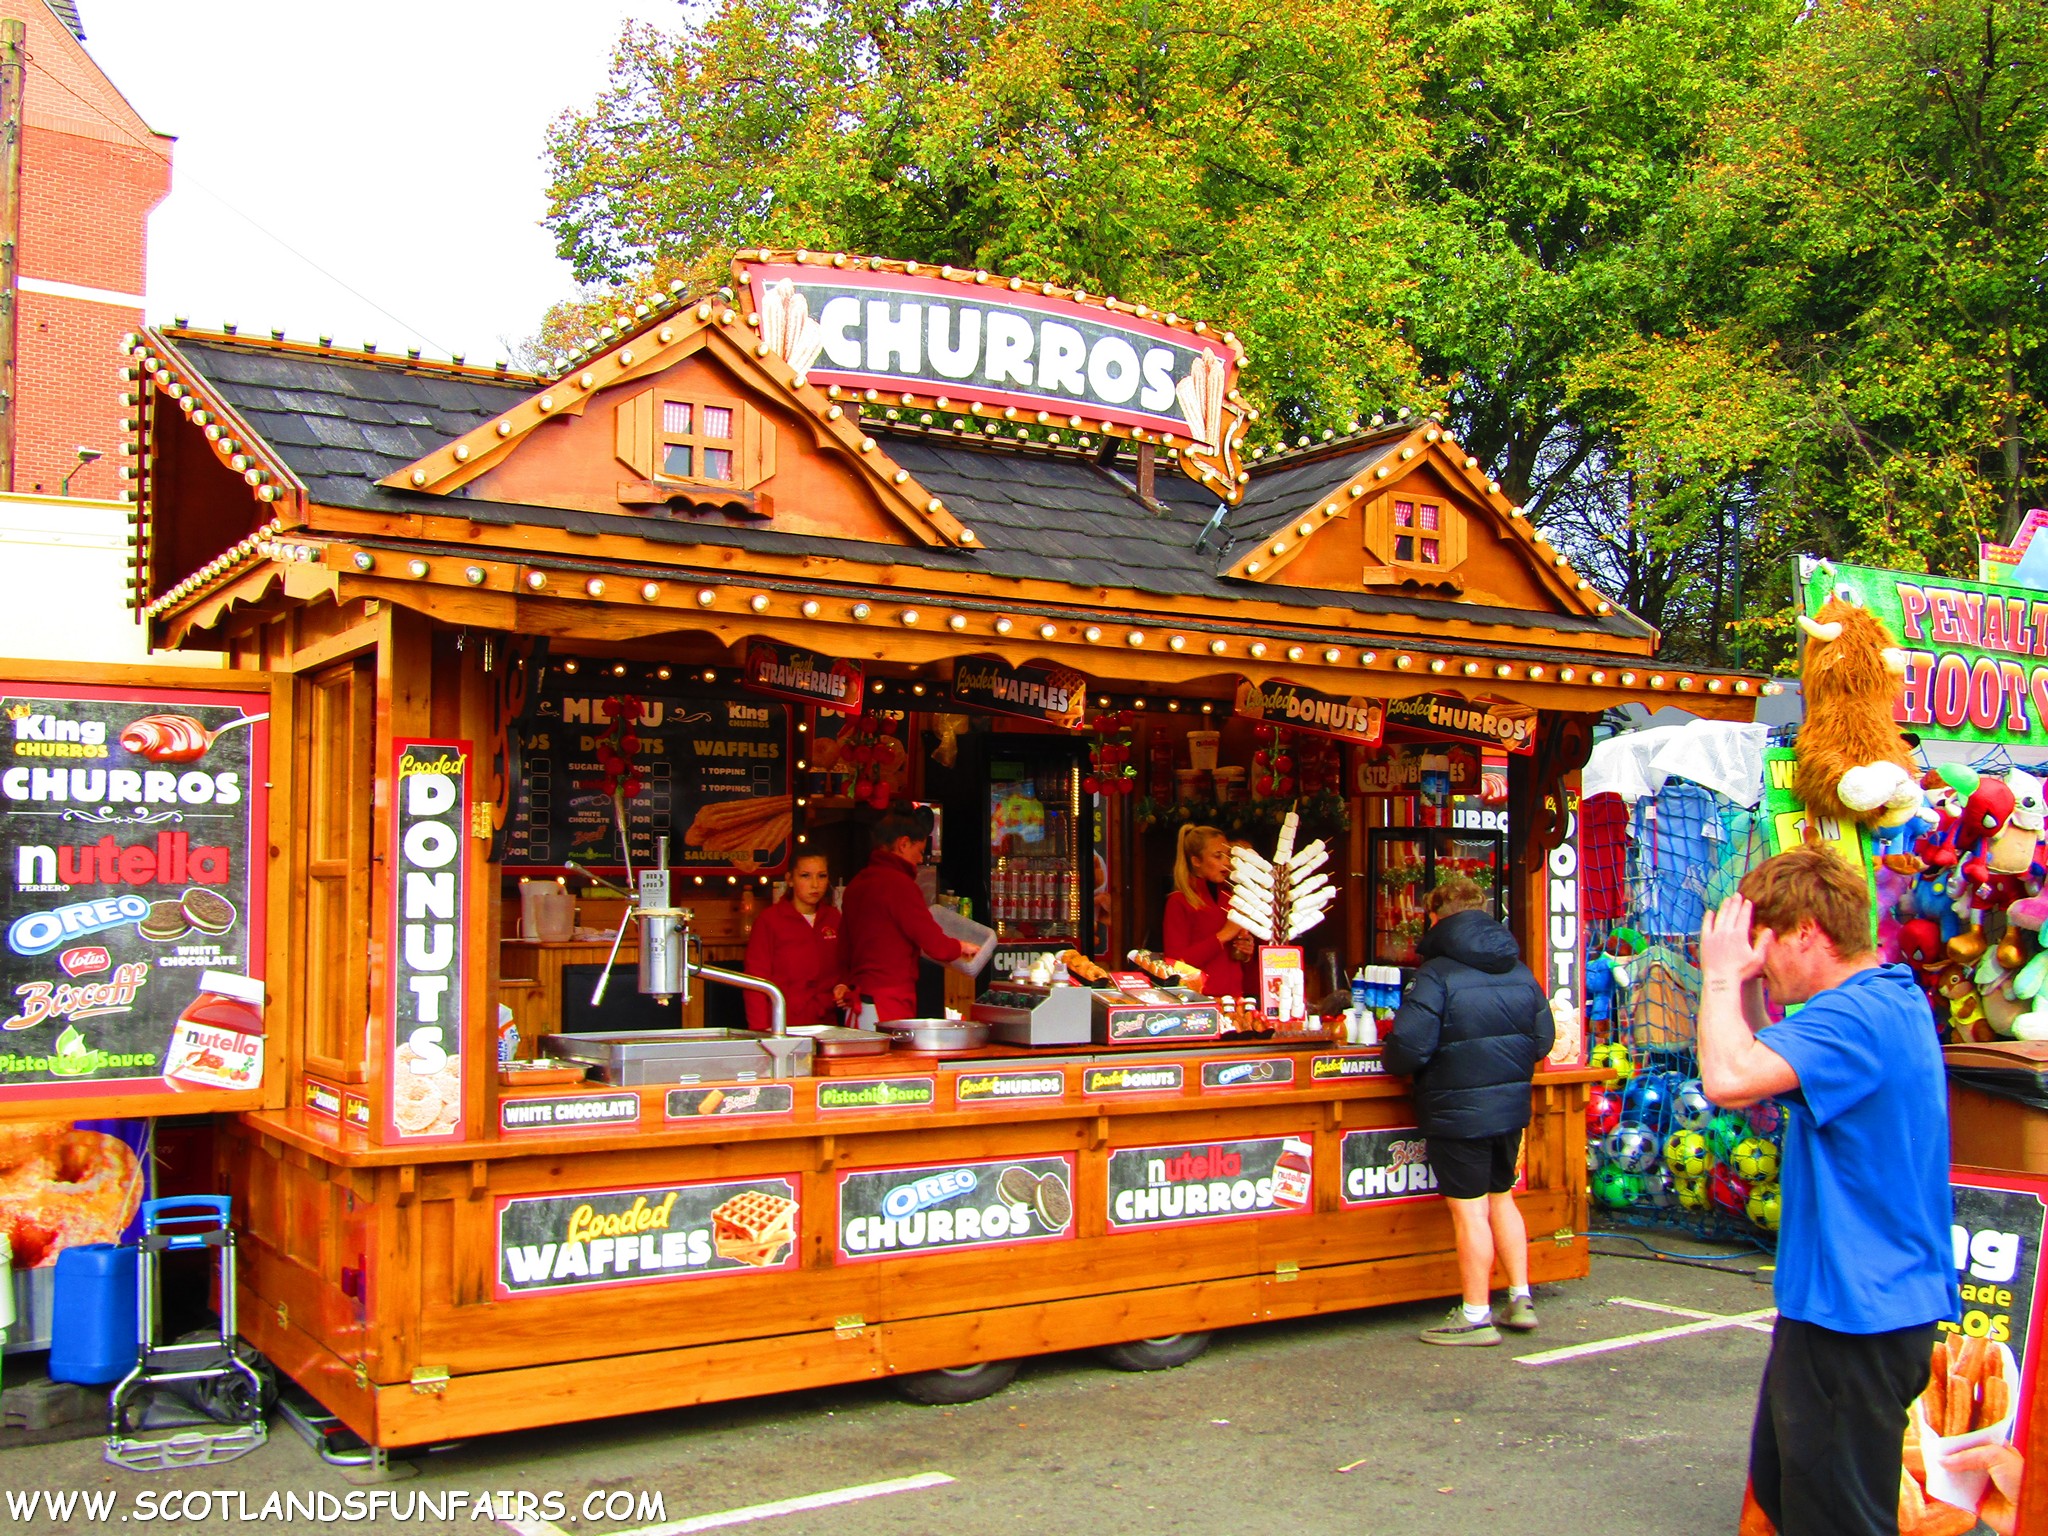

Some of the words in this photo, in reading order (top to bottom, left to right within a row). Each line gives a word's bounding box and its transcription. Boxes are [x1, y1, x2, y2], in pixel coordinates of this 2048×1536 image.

[820, 297, 1175, 412] CHURROS
[1895, 582, 2048, 657] PENALT
[760, 662, 846, 697] STRAWBERRIES
[956, 666, 1000, 691] Loaded
[993, 675, 1069, 713] WAFFLES
[1893, 650, 2048, 731] HOOT
[563, 697, 664, 728] MEU
[729, 705, 769, 721] King
[1245, 687, 1294, 710] Loaded
[1286, 698, 1368, 732] DONUTS
[1387, 696, 1436, 717] Loaded
[1428, 698, 1526, 741] CHURROS
[15, 714, 106, 745] King
[728, 719, 770, 729] CHURROS
[14, 742, 108, 758] CHURROS
[693, 740, 780, 758] WAFFLES
[399, 754, 468, 782] Loaded
[568, 763, 606, 771] SUGARE
[709, 768, 746, 776] TOPPING
[2, 767, 241, 805] CHURROS
[709, 785, 752, 793] TOPPINGS
[632, 815, 651, 823] FOR
[632, 832, 651, 841] FOR
[18, 831, 230, 885] nutella
[631, 849, 650, 857] FOR
[19, 884, 71, 892] FERRERO
[16, 894, 148, 950] OREO
[404, 774, 458, 1076] DONUTS
[67, 950, 107, 971] Lotus
[159, 955, 238, 967] CHOCOLATE
[177, 945, 221, 956] WHITE
[3, 961, 148, 1031] Biscoff
[186, 1029, 259, 1057] nutella
[97, 1051, 156, 1068] Sauce
[1313, 1058, 1345, 1077] Loaded
[1341, 1060, 1385, 1074] WAFFLE
[960, 1077, 1000, 1098] Loaded
[992, 1078, 1060, 1094] CHURROS
[1091, 1070, 1125, 1091] Loaded
[1121, 1072, 1175, 1087] DONUTS
[1219, 1064, 1252, 1084] OREO
[889, 1088, 929, 1102] Sauce
[506, 1106, 552, 1123] WHITE
[555, 1101, 636, 1121] CHOCOLATE
[1148, 1146, 1241, 1182] nutella
[1386, 1138, 1428, 1175] Bisc
[1277, 1171, 1307, 1186] nutella
[1348, 1163, 1439, 1197] CHUR
[885, 1171, 975, 1217] OREO
[1115, 1178, 1274, 1221] CHURROS
[567, 1191, 679, 1250] Loaded
[845, 1202, 1031, 1251] CHURROS
[506, 1229, 712, 1283] WAFFLES
